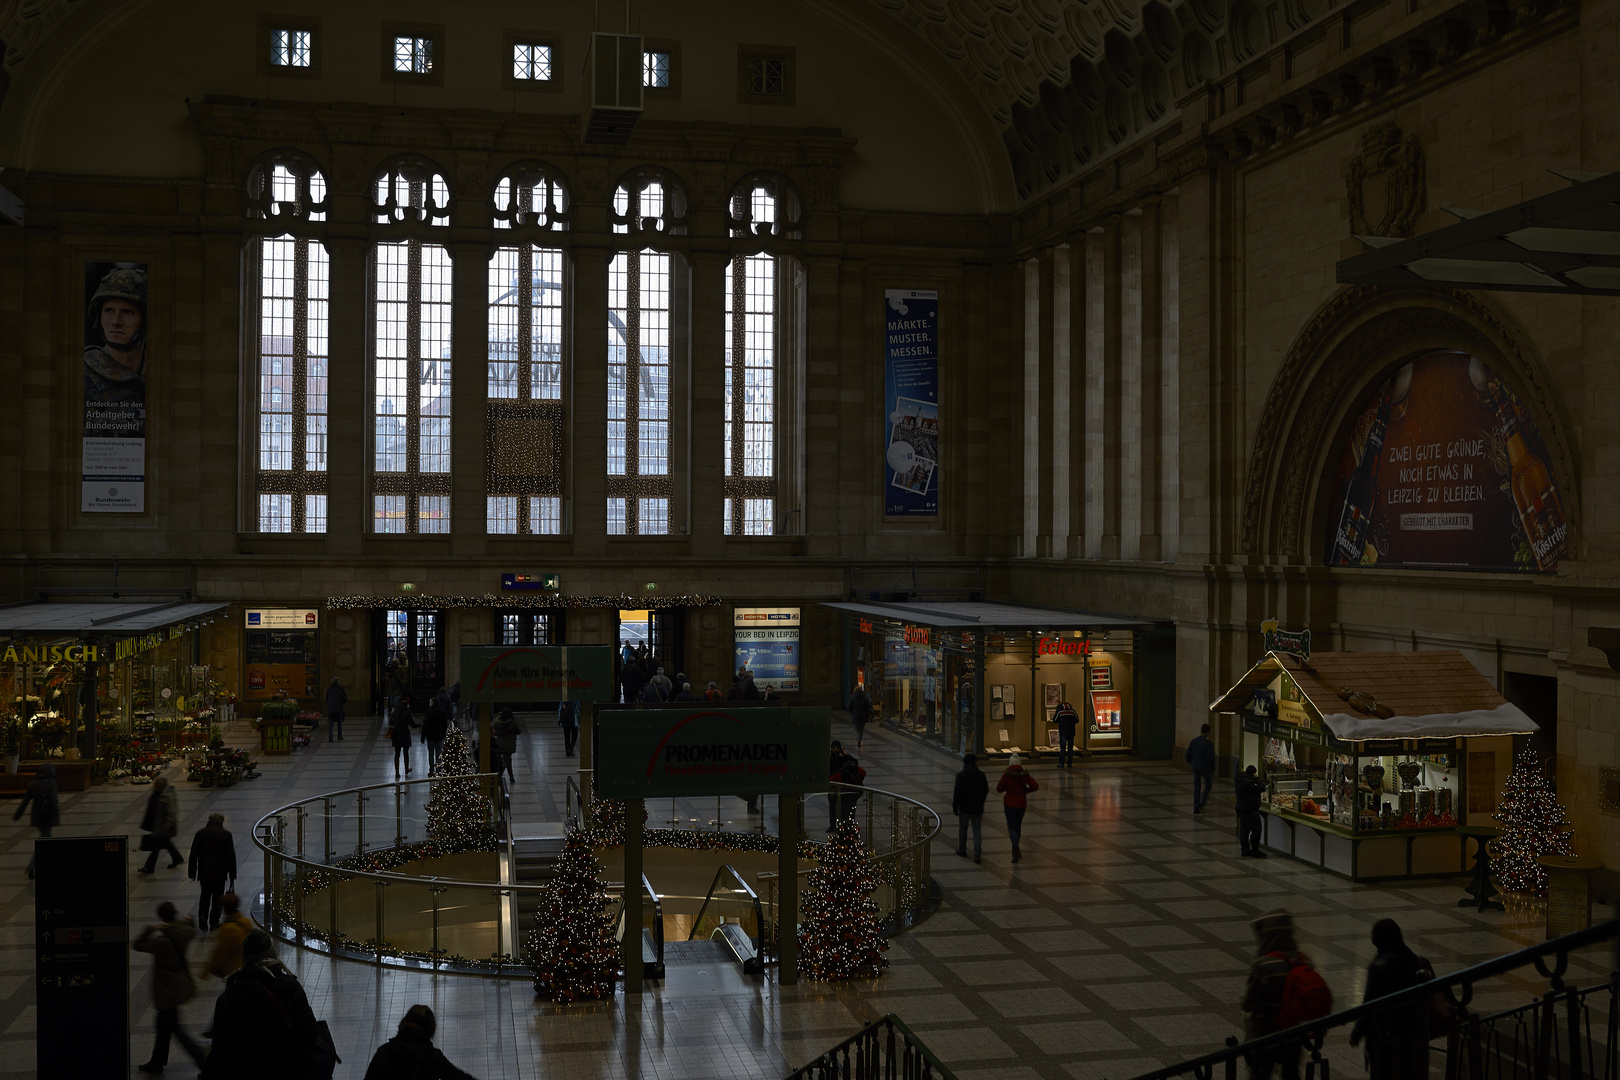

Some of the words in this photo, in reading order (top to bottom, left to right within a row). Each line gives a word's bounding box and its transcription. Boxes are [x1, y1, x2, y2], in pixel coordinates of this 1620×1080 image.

[888, 319, 931, 330] MÄRKTE.
[889, 333, 932, 344] MUSTER.
[890, 346, 932, 357] MESSEN.
[86, 410, 135, 420] Arbeitgeber
[86, 422, 139, 430] Bundeswehr!
[1389, 446, 1412, 463] ZWEI
[1416, 443, 1441, 461] GUTE
[1446, 438, 1486, 460] GRÜNDE,
[1400, 467, 1422, 483] NOCH
[1426, 463, 1458, 482] ETWAS
[1463, 464, 1473, 480] IN
[1388, 488, 1422, 504] LEIPZIG
[1427, 487, 1440, 503] ZU
[1443, 485, 1486, 503] BLEIBEN.
[1426, 517, 1436, 526] MIT
[1438, 516, 1470, 526] CHARAKTER
[910, 628, 929, 645] LOTTO
[1038, 638, 1092, 654] Eckert
[493, 667, 517, 677] Alles
[521, 667, 539, 677] fürs
[493, 678, 524, 688] Leben
[526, 678, 544, 688] und
[665, 743, 787, 762] PROMENADEN
[665, 764, 743, 777] Hauptbahnhof
[748, 762, 786, 775] Leipzig
[106, 843, 118, 851] DB
